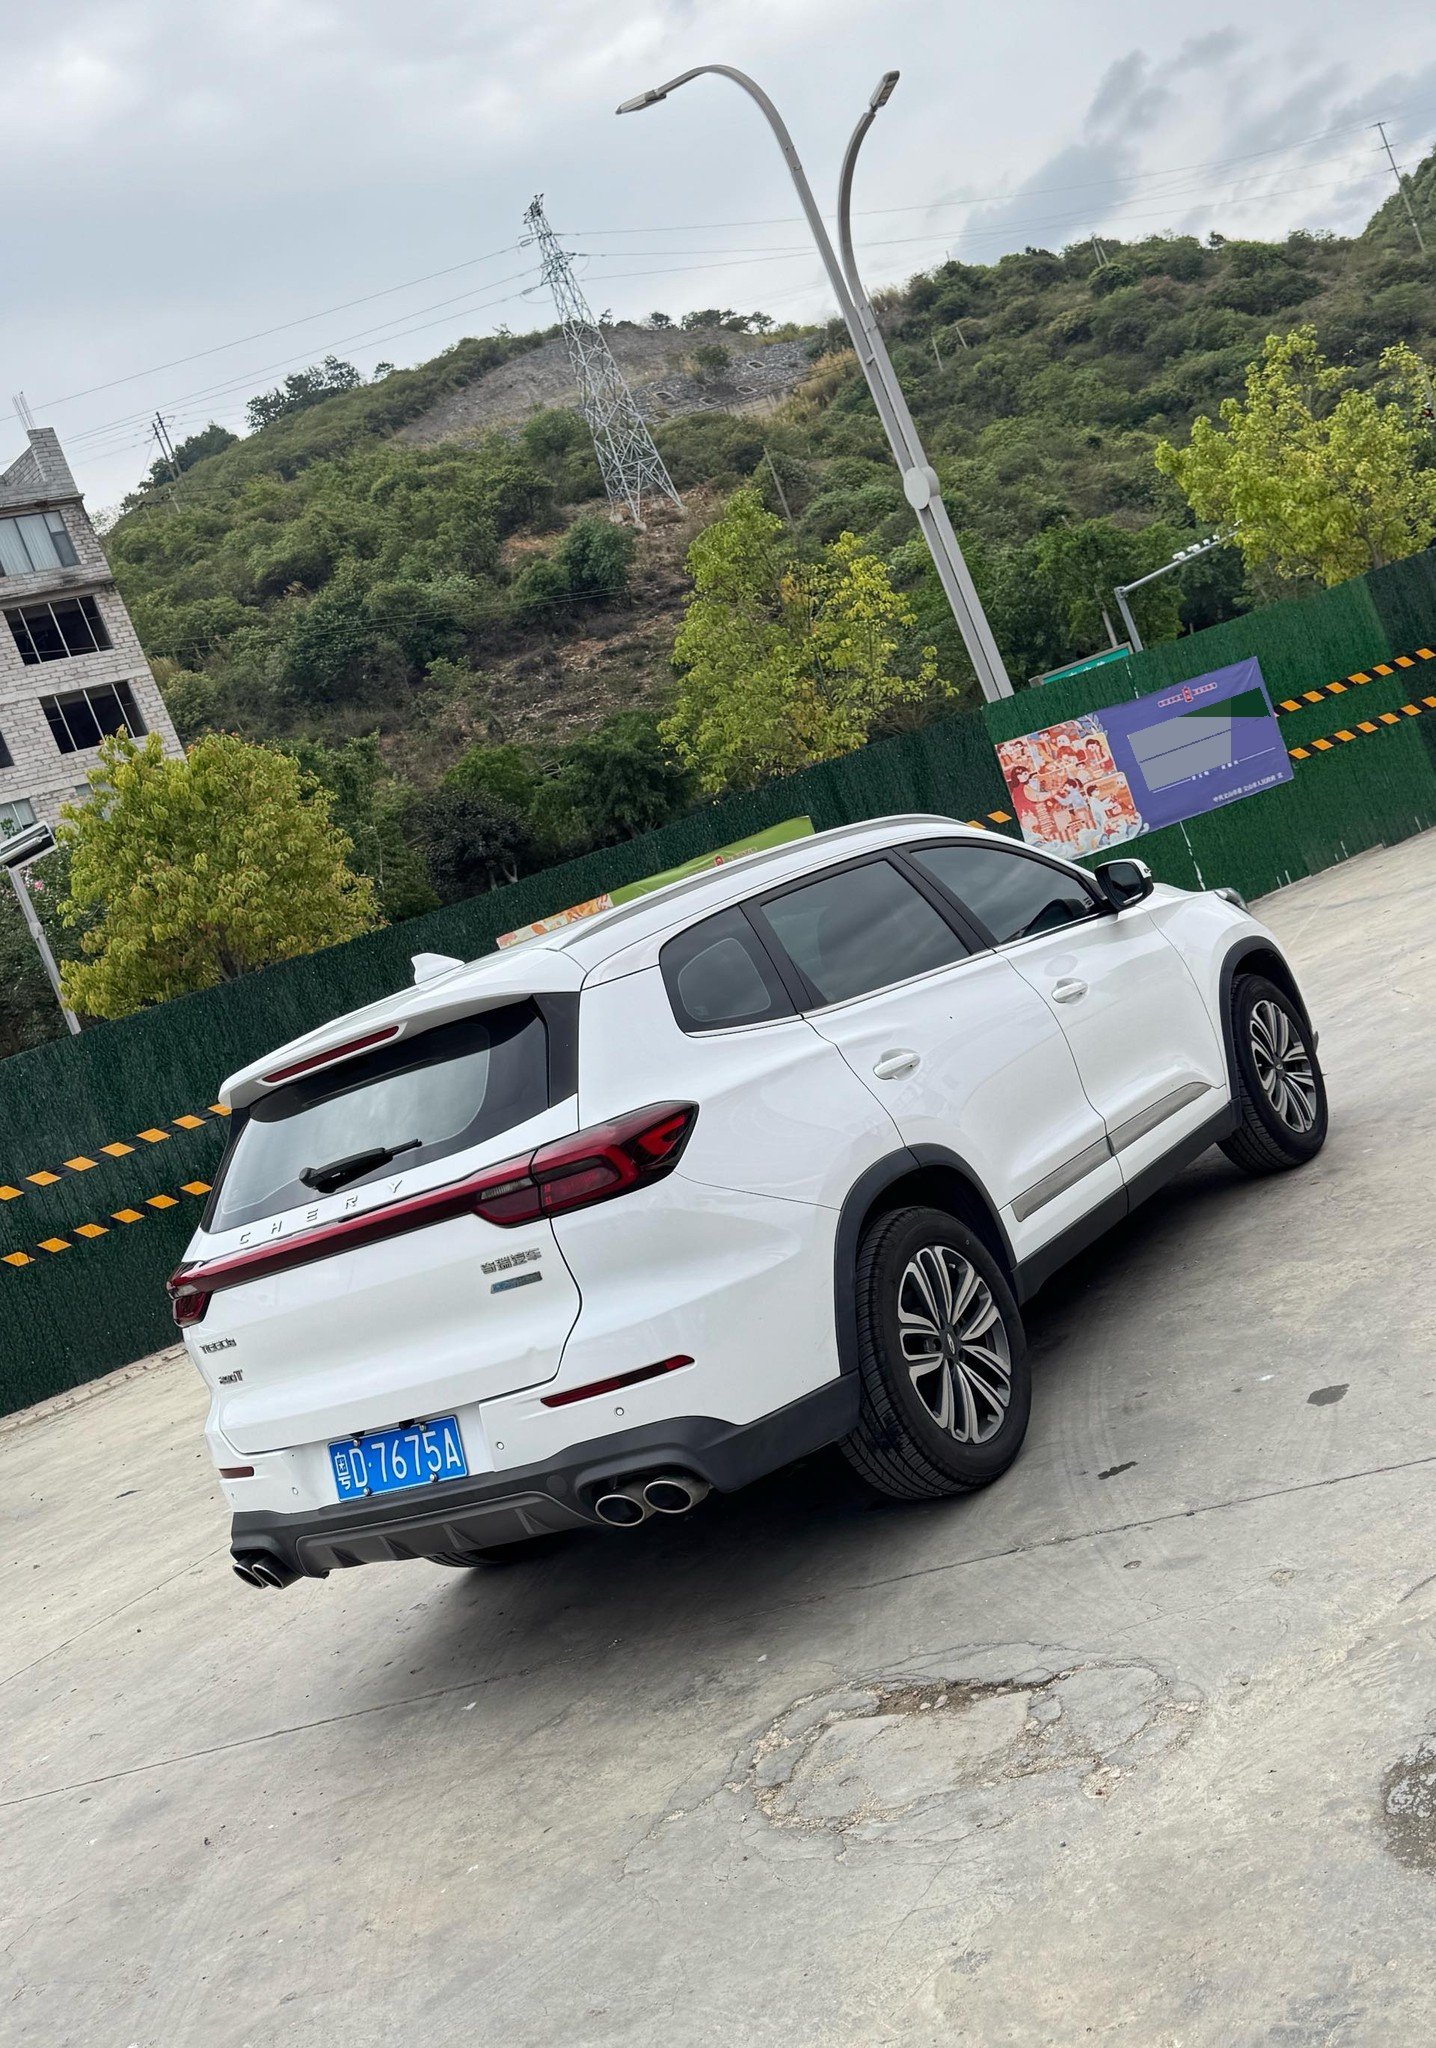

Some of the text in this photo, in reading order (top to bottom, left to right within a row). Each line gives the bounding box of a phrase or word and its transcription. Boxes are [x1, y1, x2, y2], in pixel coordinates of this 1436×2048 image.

[239, 1179, 402, 1244] CHERY
[481, 1247, 542, 1274] 奇瑞汽车
